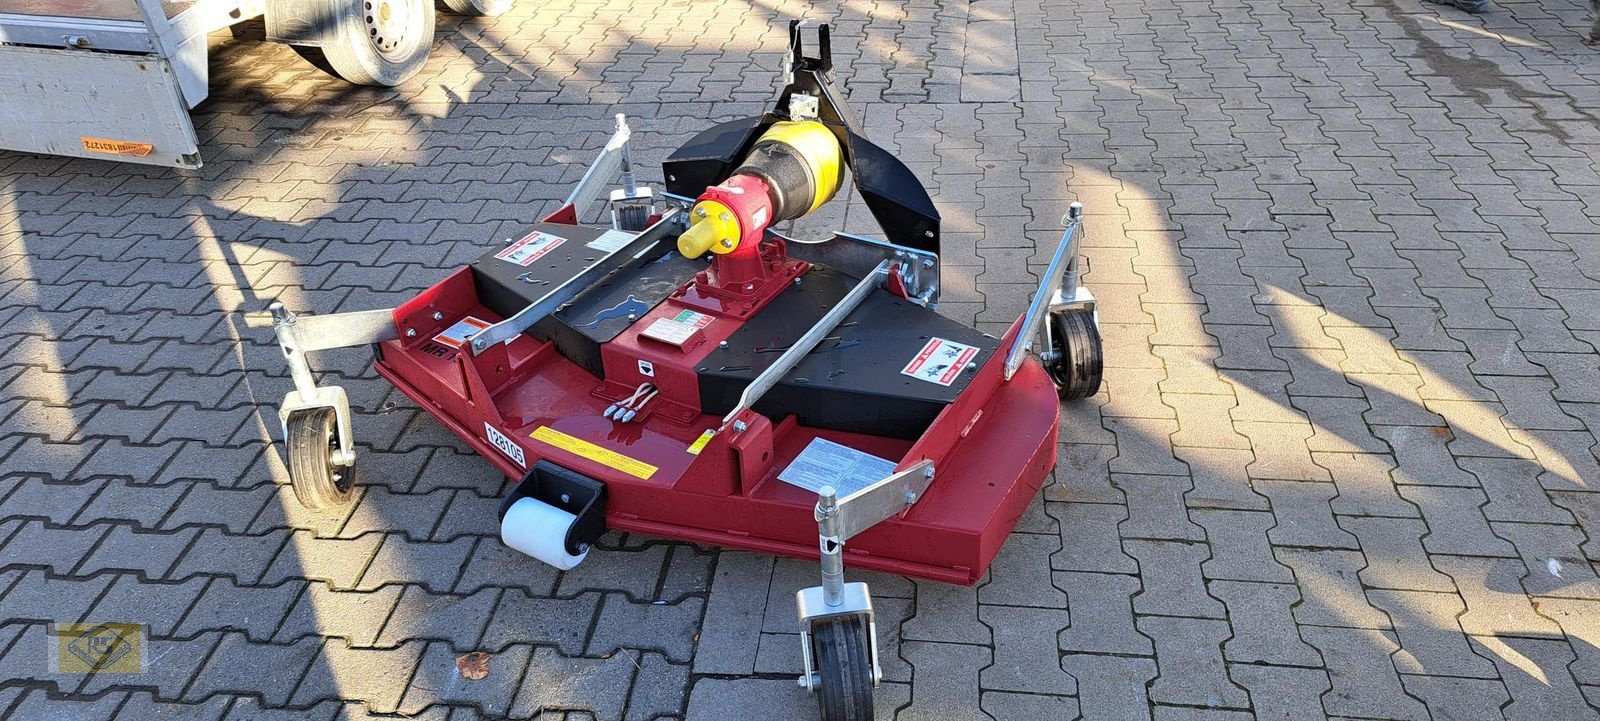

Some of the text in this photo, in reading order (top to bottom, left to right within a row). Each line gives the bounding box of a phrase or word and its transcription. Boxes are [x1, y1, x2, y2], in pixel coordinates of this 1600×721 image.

[84, 141, 118, 151] 1831272
[420, 343, 448, 357] MR
[488, 428, 523, 463] 128105
